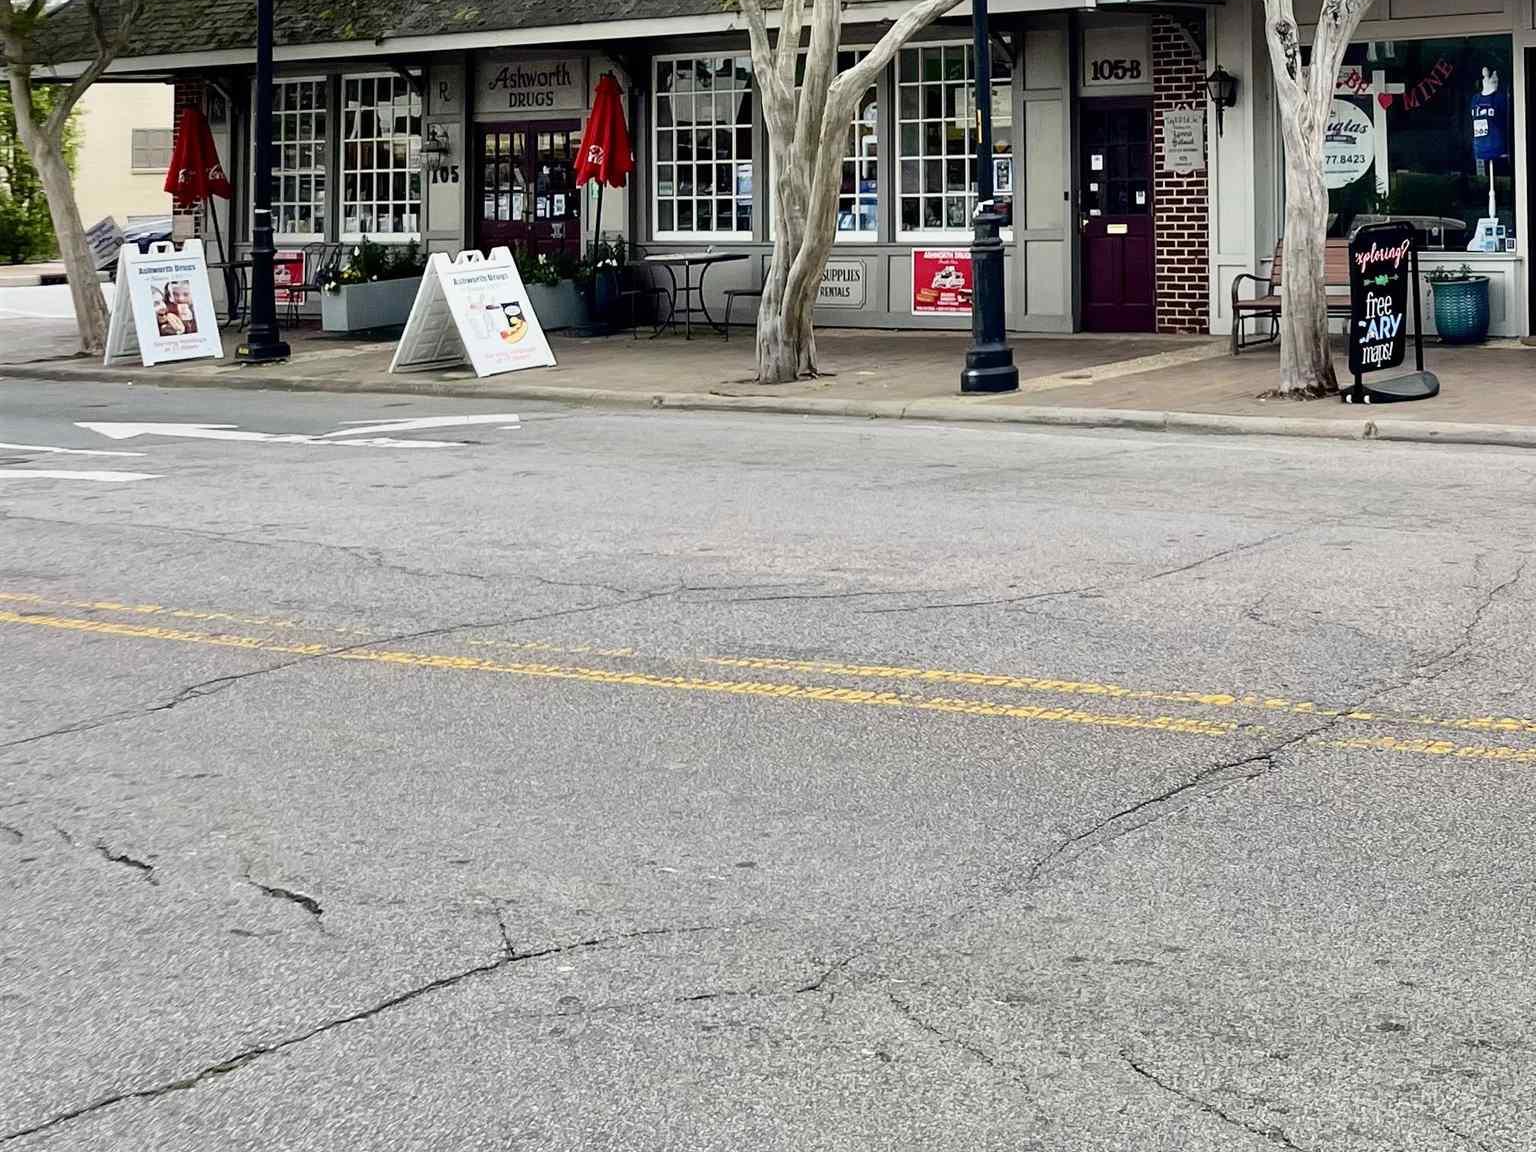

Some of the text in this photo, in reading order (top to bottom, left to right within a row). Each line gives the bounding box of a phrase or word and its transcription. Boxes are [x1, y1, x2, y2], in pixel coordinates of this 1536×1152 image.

[488, 61, 572, 91] Ashworth
[1402, 59, 1456, 112] MINE
[508, 91, 555, 108] DRUGS
[1327, 119, 1368, 136] glas
[1354, 239, 1410, 273] xploring?
[138, 265, 174, 274] Ashworth
[822, 268, 861, 282] SUPPLIES
[819, 286, 850, 298] RENTALS
[1365, 291, 1392, 319] free
[1361, 341, 1394, 368] maps!
